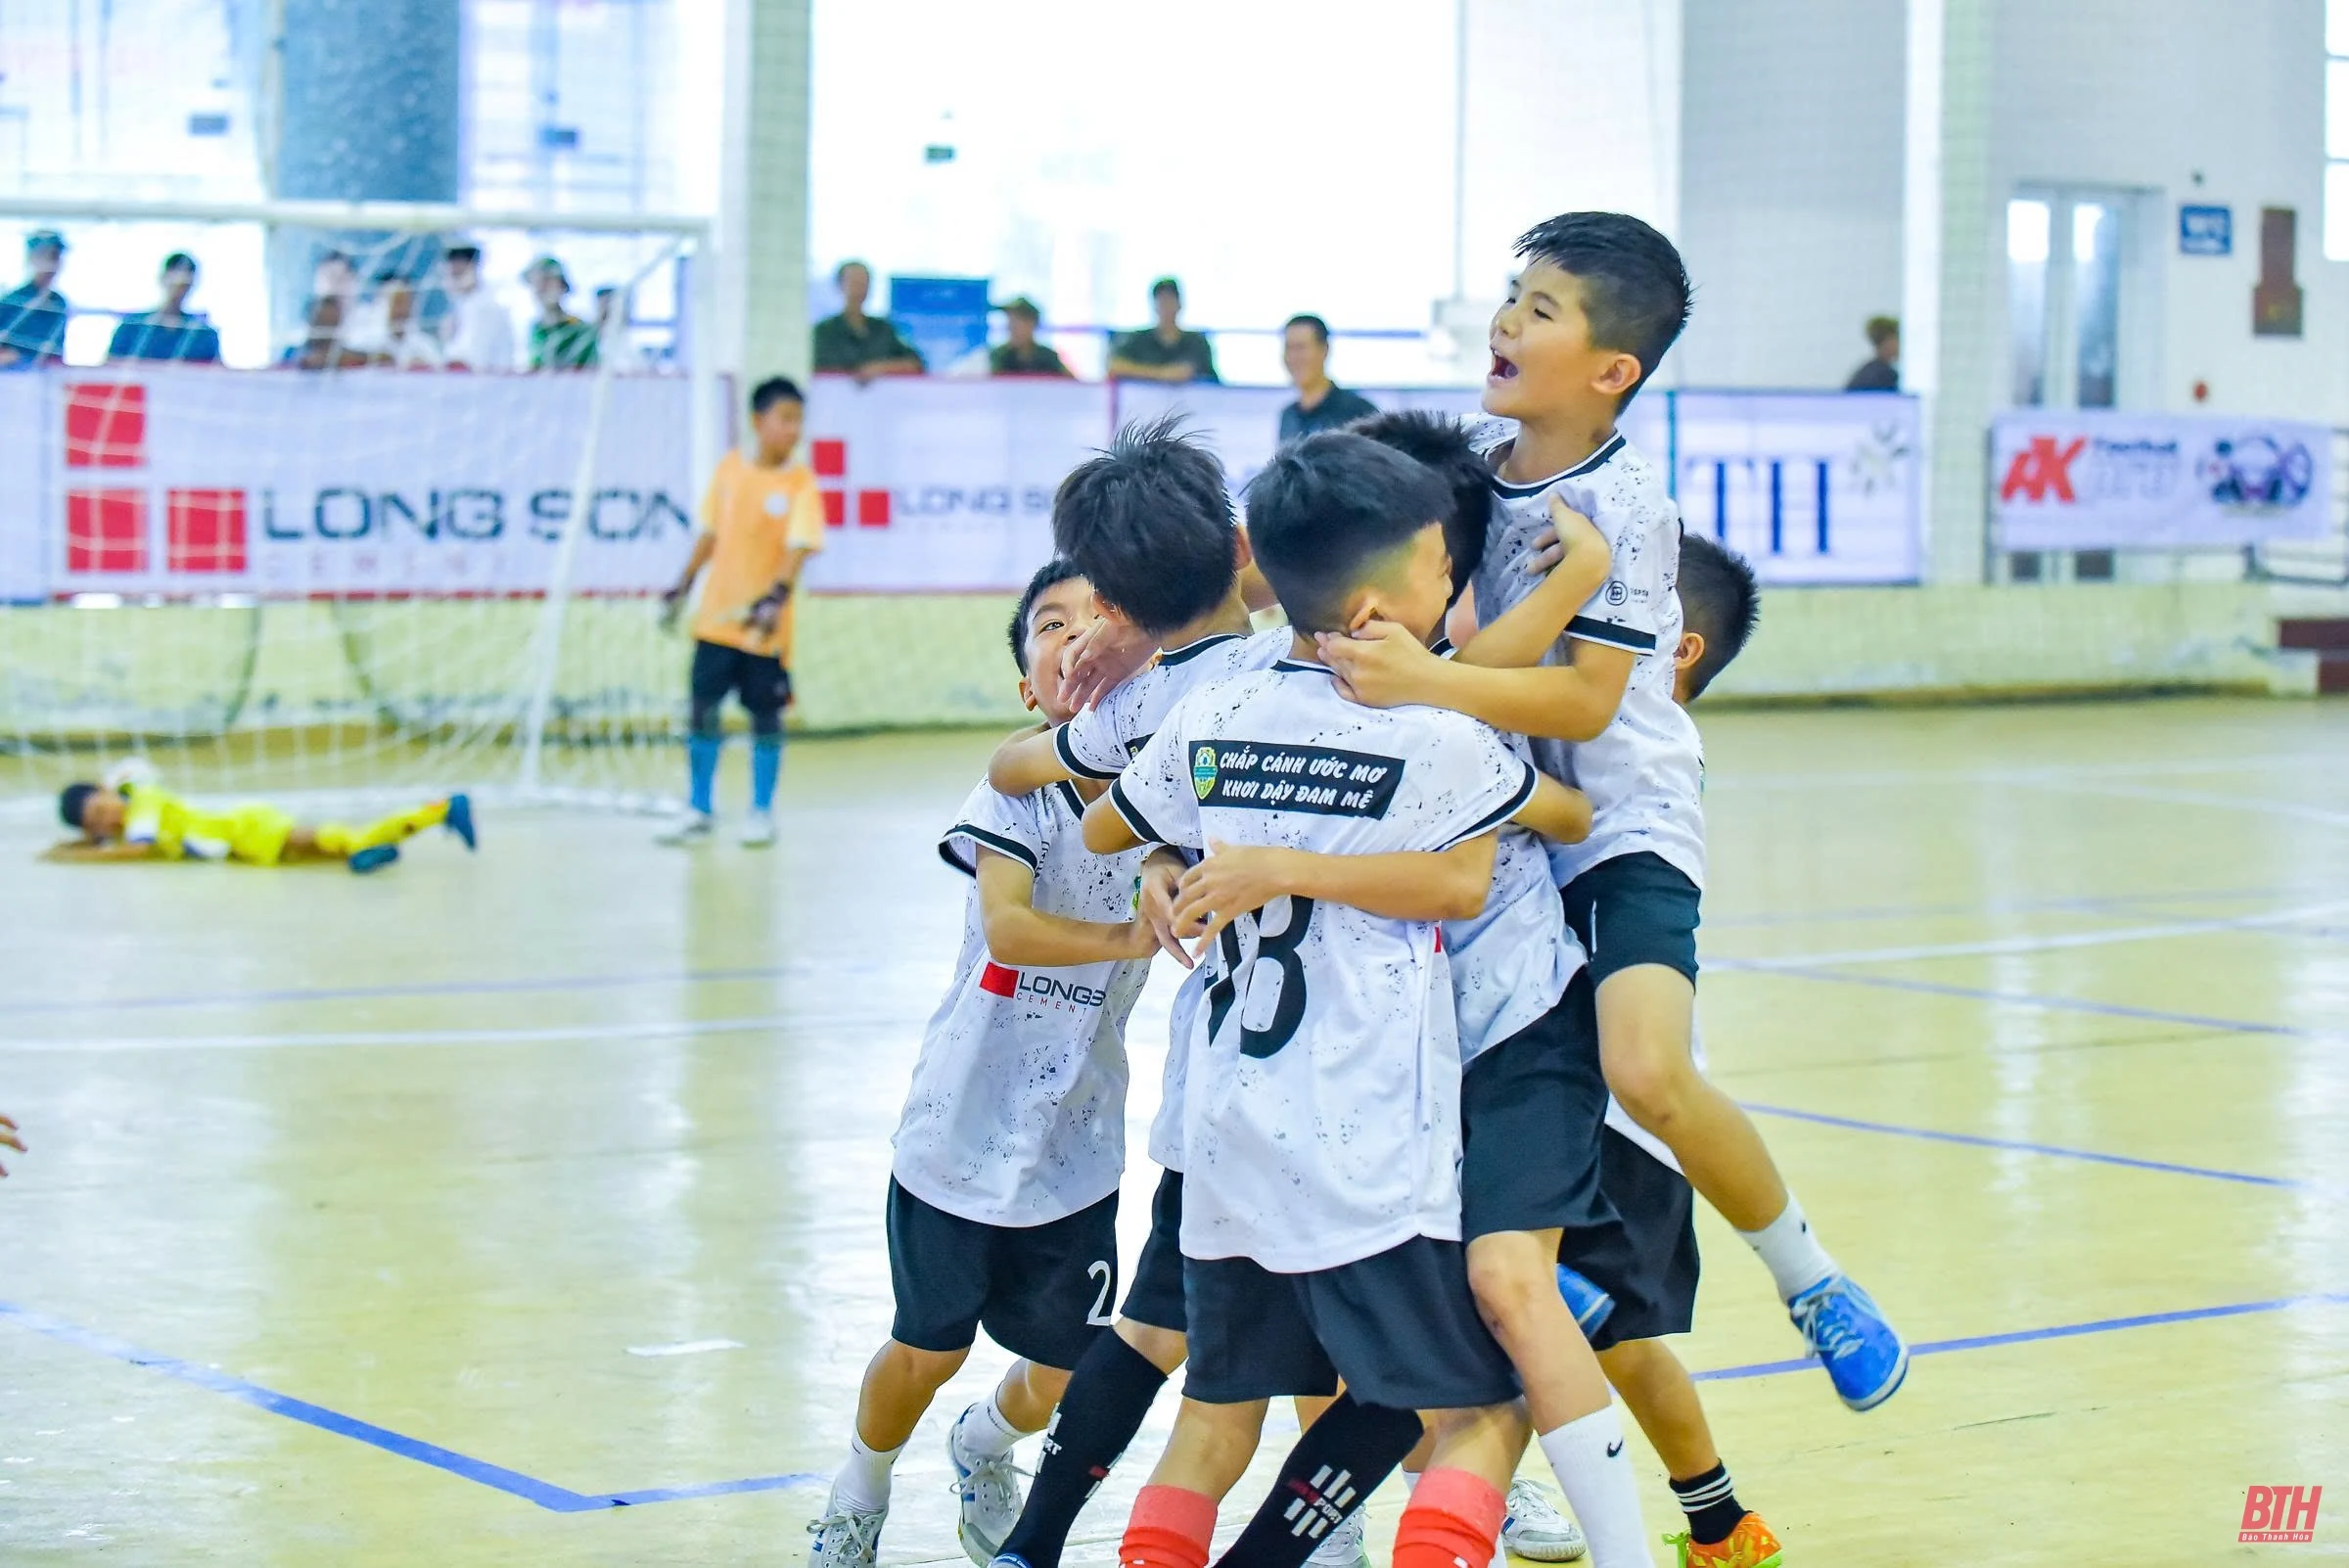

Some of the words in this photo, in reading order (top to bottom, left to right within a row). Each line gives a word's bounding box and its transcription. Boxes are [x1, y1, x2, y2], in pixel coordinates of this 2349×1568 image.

[262, 487, 506, 540] LONG
[1262, 752, 1307, 774] CÁNH
[1309, 755, 1348, 778] ƯỚC
[1349, 765, 1388, 784] MƠ
[1261, 779, 1295, 806] DẬY
[1295, 784, 1338, 806] ĐAM
[1340, 789, 1374, 809] MÊ
[1016, 992, 1087, 1016] CEMENT
[1085, 1260, 1112, 1326] 2
